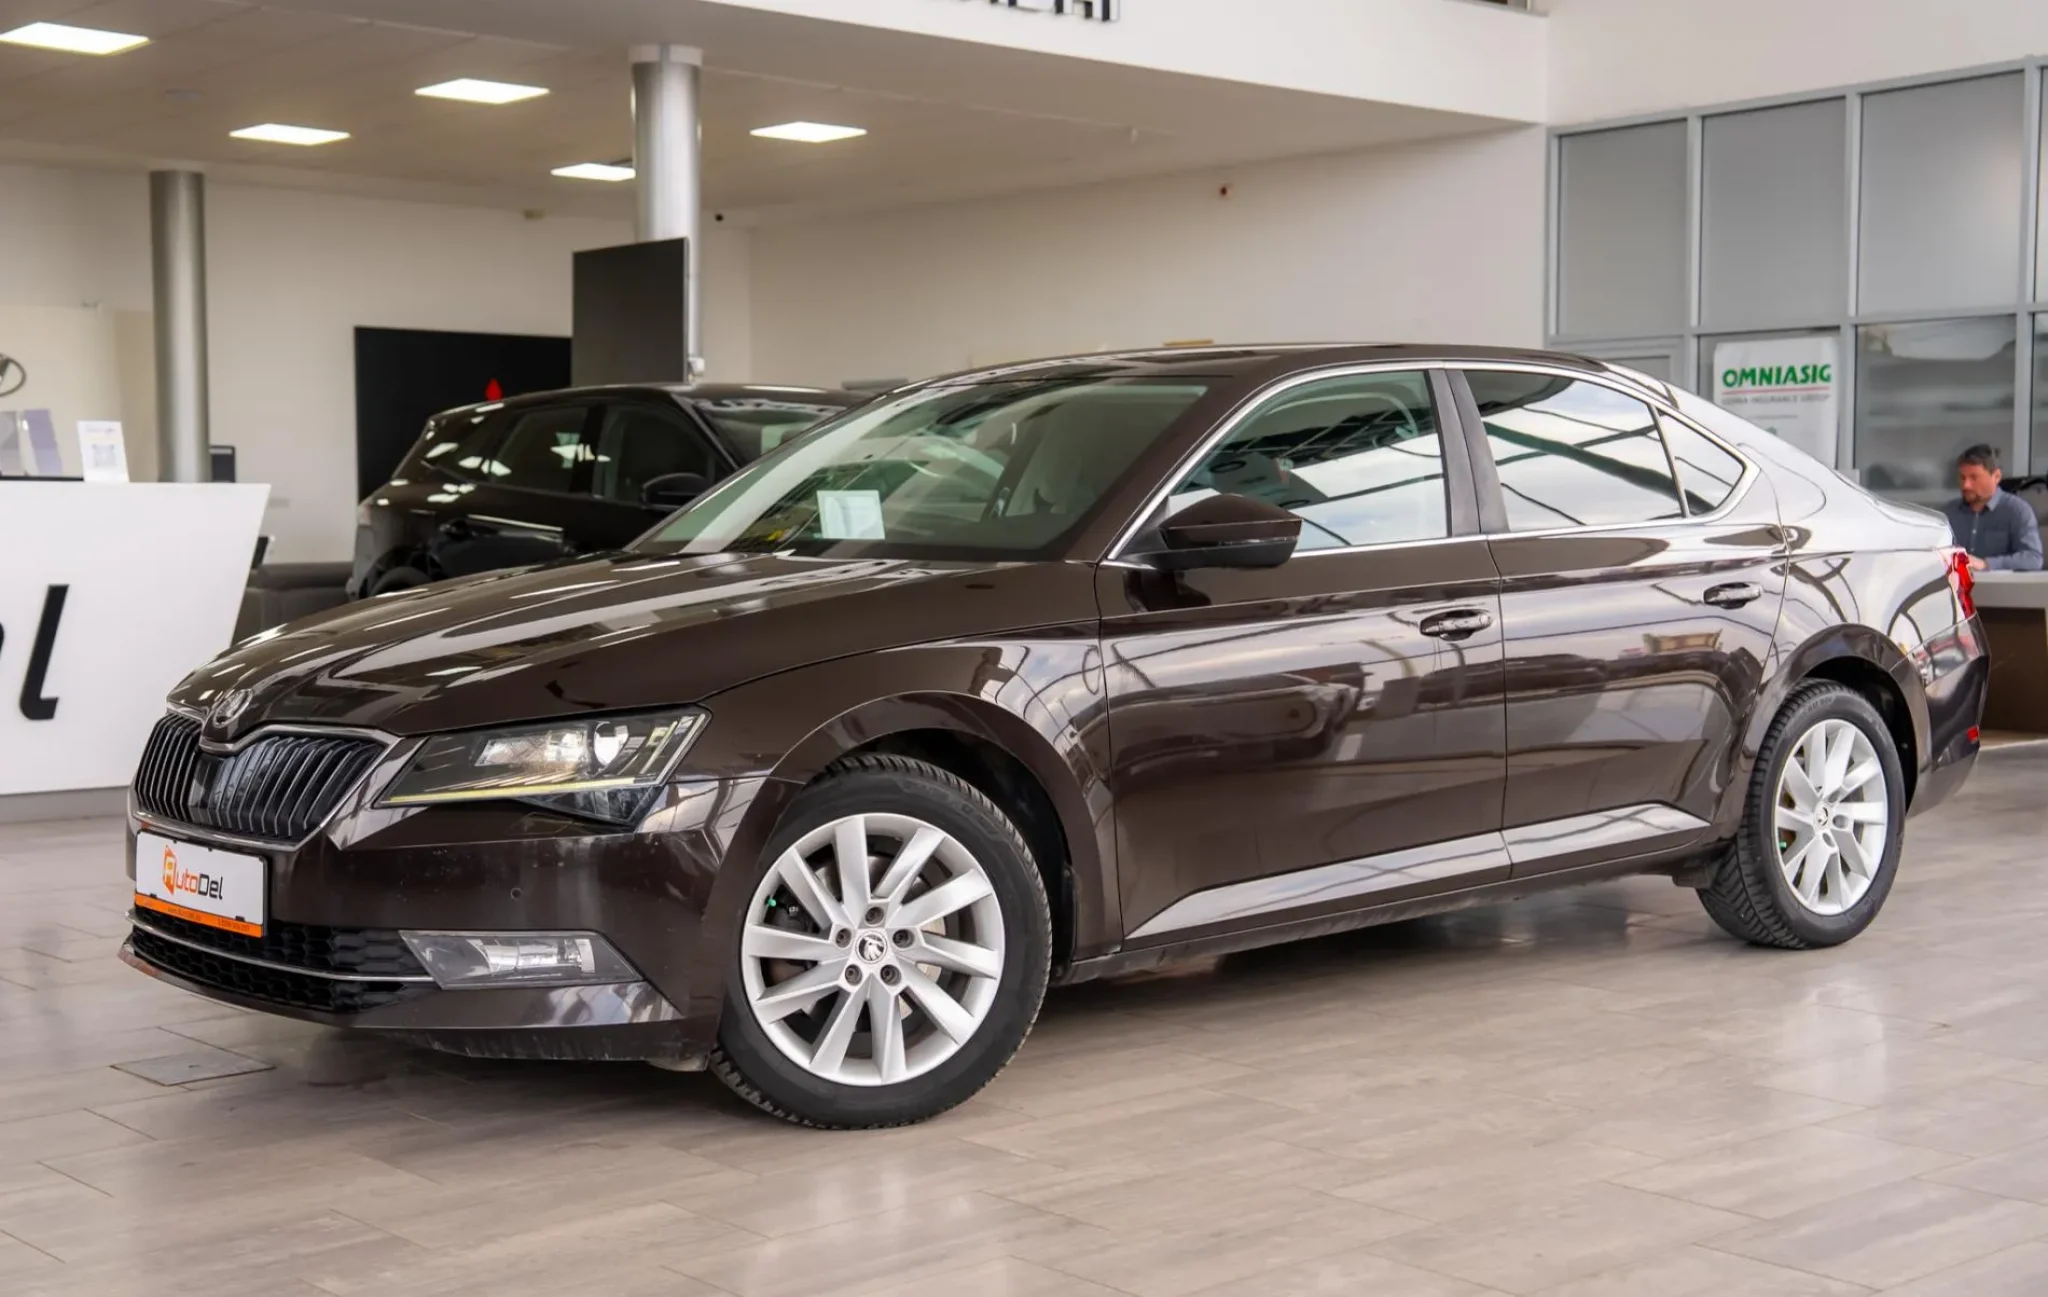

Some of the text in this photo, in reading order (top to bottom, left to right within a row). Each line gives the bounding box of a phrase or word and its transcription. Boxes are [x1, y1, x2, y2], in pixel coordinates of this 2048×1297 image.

[1722, 364, 1831, 388] OMNIASIG
[0, 584, 70, 720] l
[163, 844, 223, 900] AutoDel
